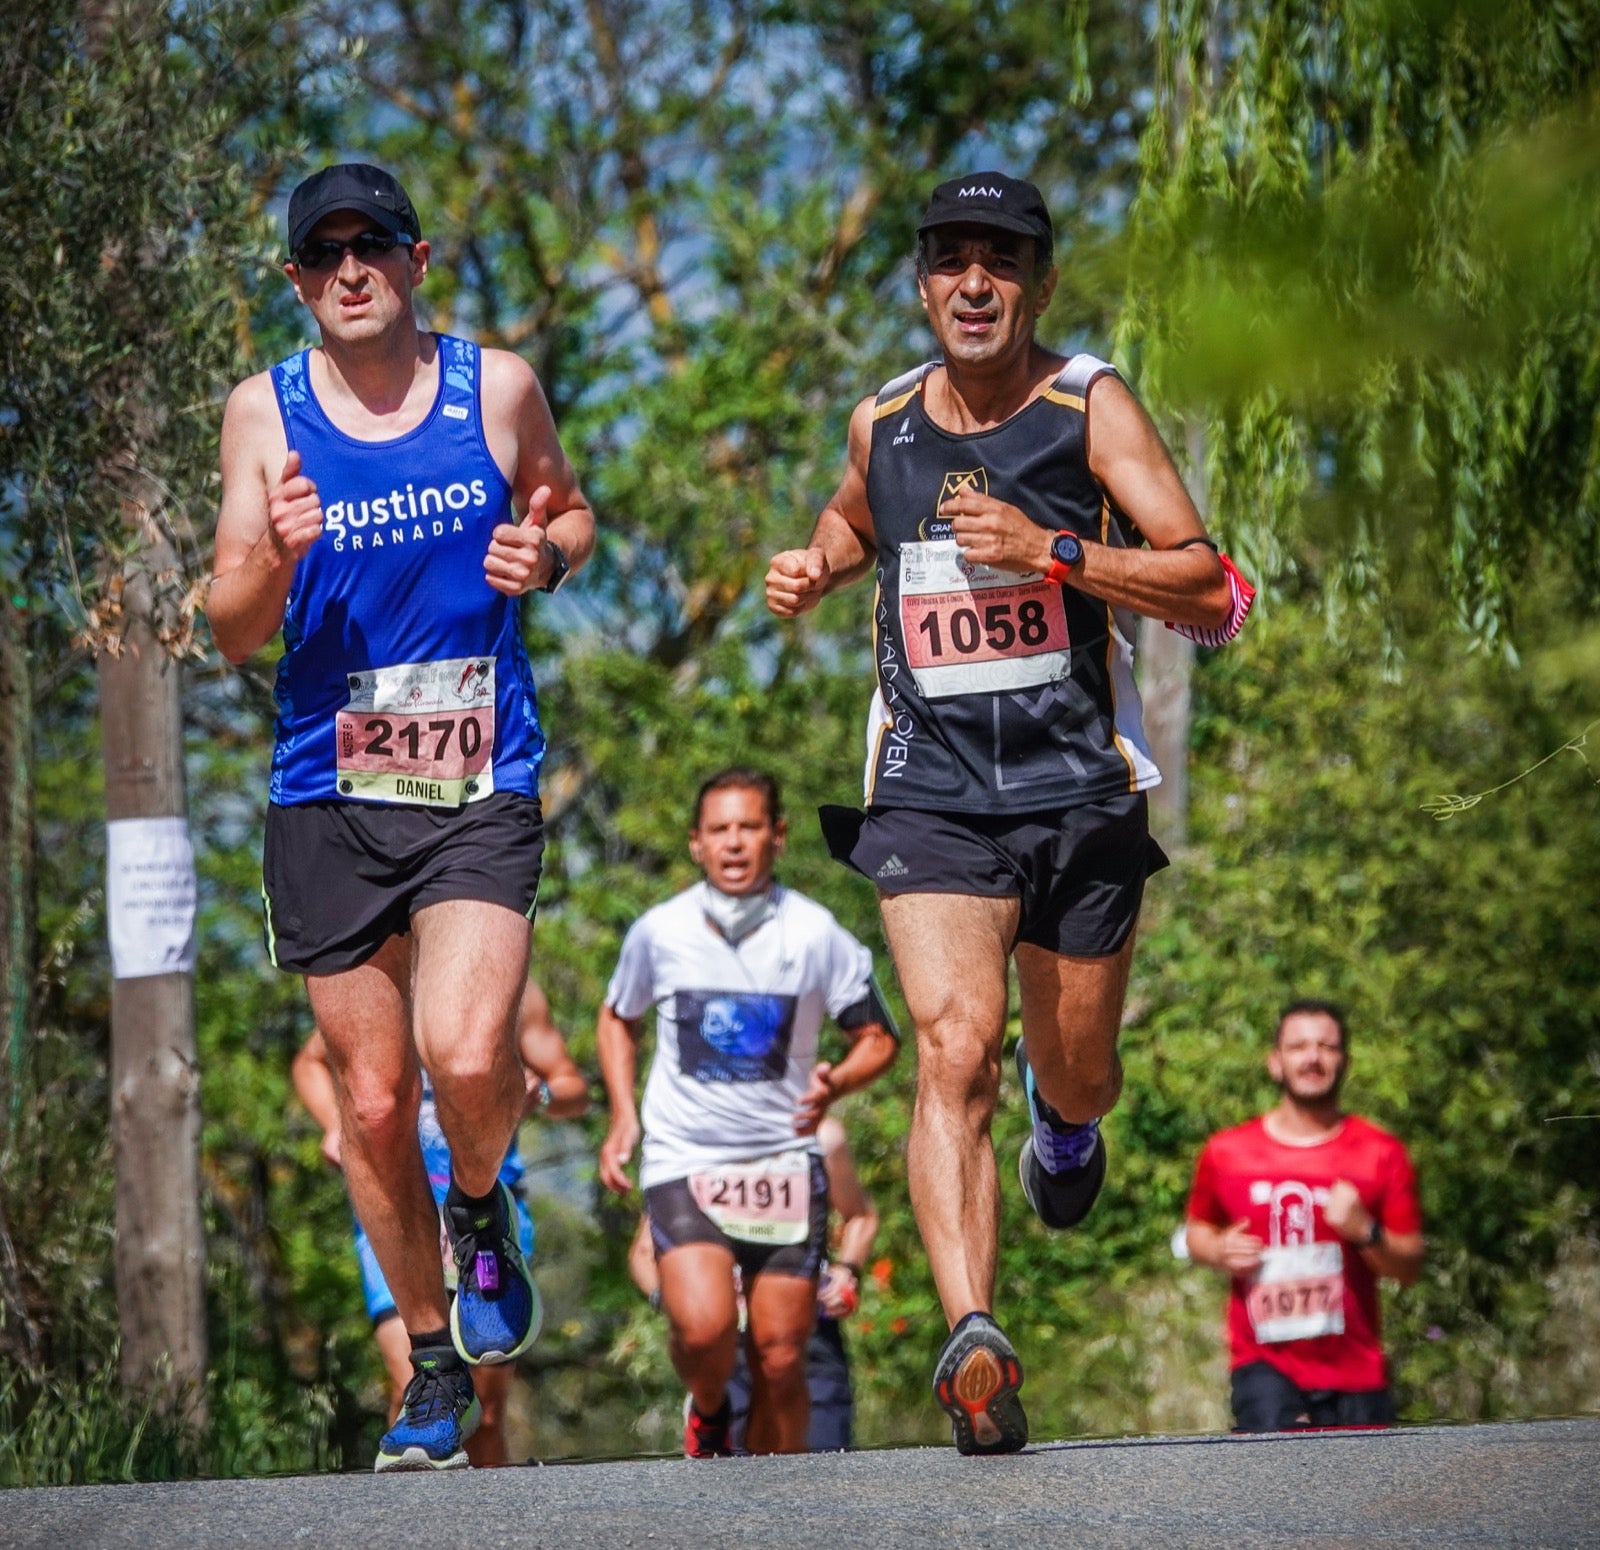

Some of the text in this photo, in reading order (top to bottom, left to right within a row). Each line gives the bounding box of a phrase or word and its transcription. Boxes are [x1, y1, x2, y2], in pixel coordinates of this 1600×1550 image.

[958, 186, 1003, 199] MAN
[318, 479, 487, 541] gustinos
[333, 516, 464, 552] GRANADA
[919, 599, 1049, 657] 1058
[364, 716, 482, 761] 2170
[396, 778, 445, 801] DANIEL
[711, 1179, 791, 1210] 2191
